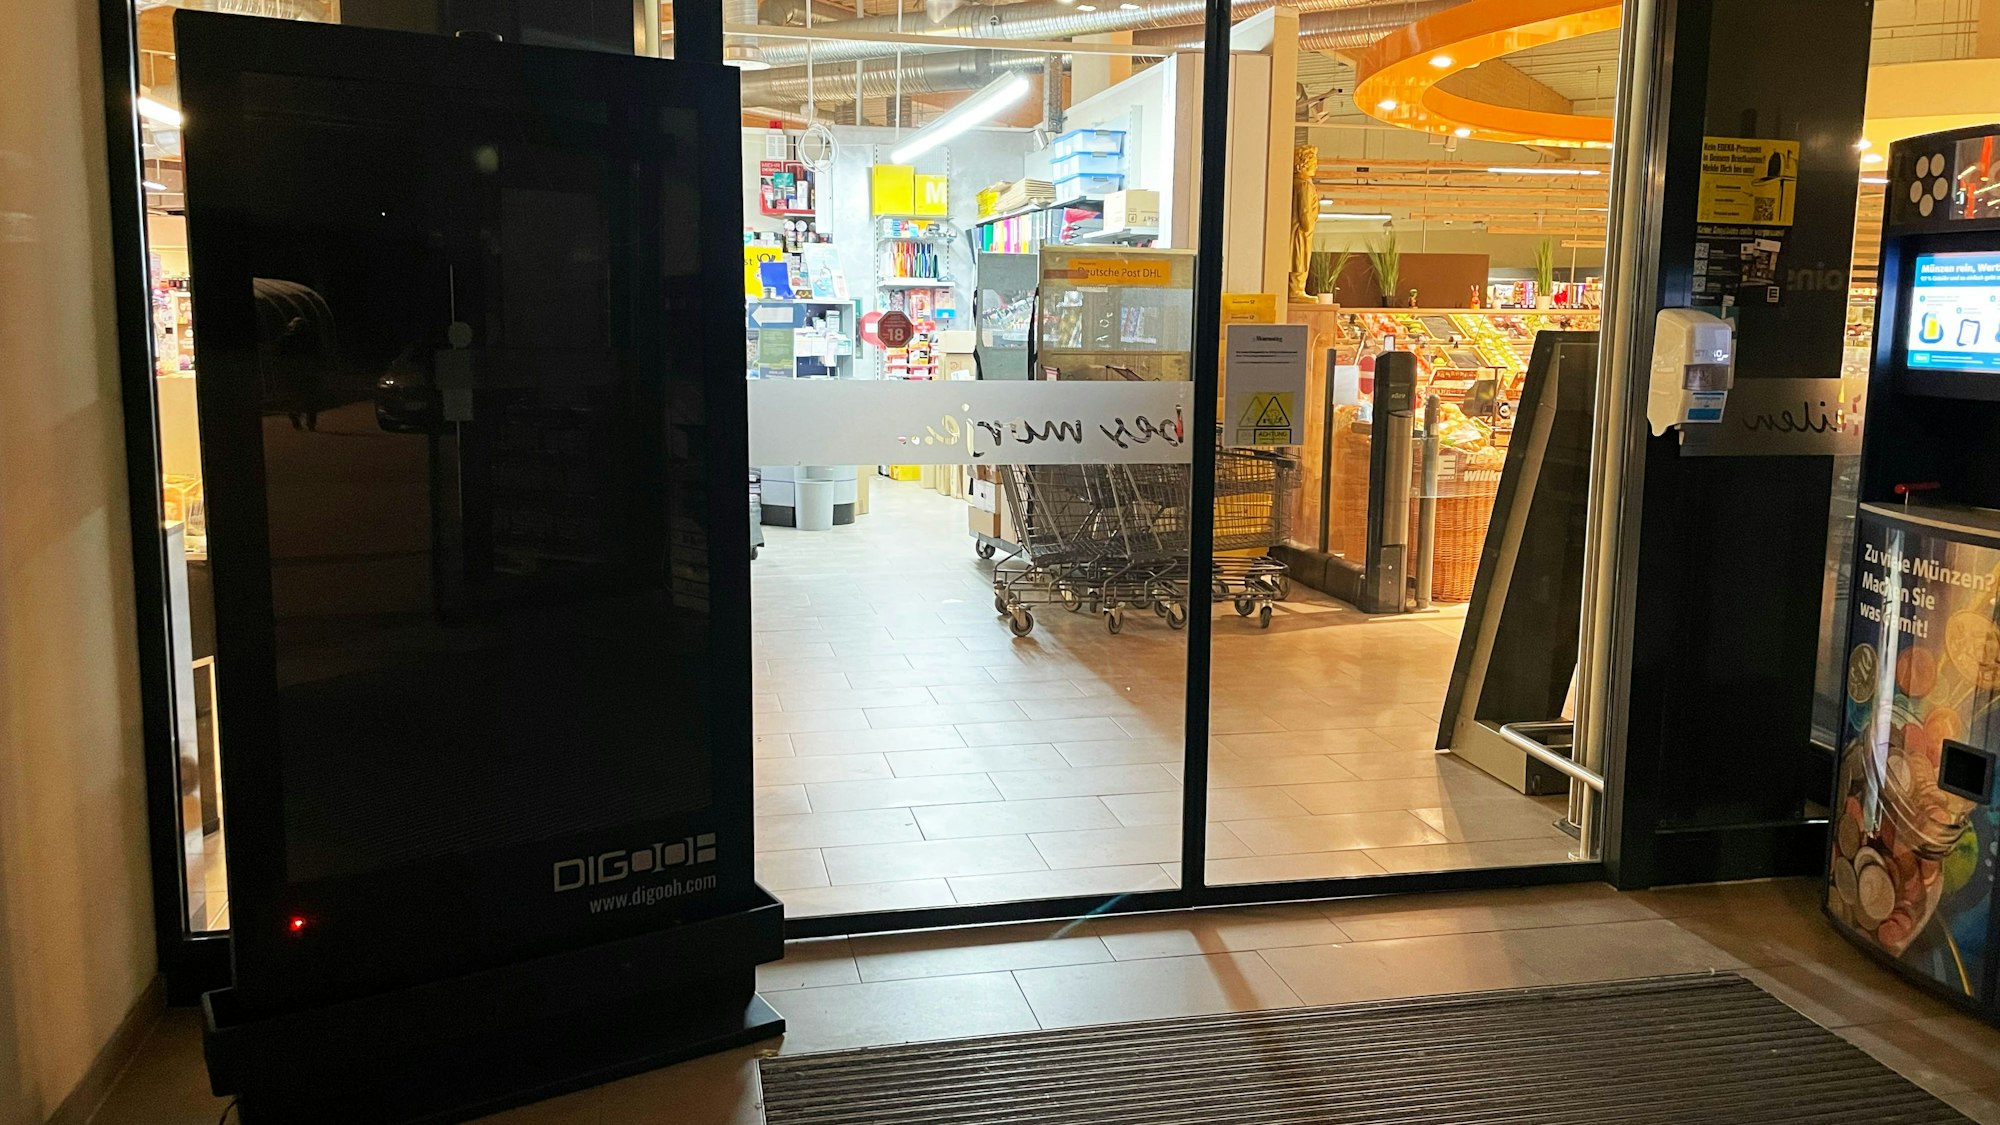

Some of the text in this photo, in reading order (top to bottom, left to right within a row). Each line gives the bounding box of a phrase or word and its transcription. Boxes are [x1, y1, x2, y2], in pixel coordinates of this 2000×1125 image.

[1078, 267, 1161, 278] Deutsche Post DHL
[1921, 262, 1955, 273] Münzen
[887, 328, 904, 341] 18
[1864, 543, 1879, 565] Zu
[1912, 557, 1995, 593] Münzen?
[1912, 587, 1936, 610] Sie
[1860, 602, 1881, 623] was
[589, 874, 717, 914] www.digooh.com
